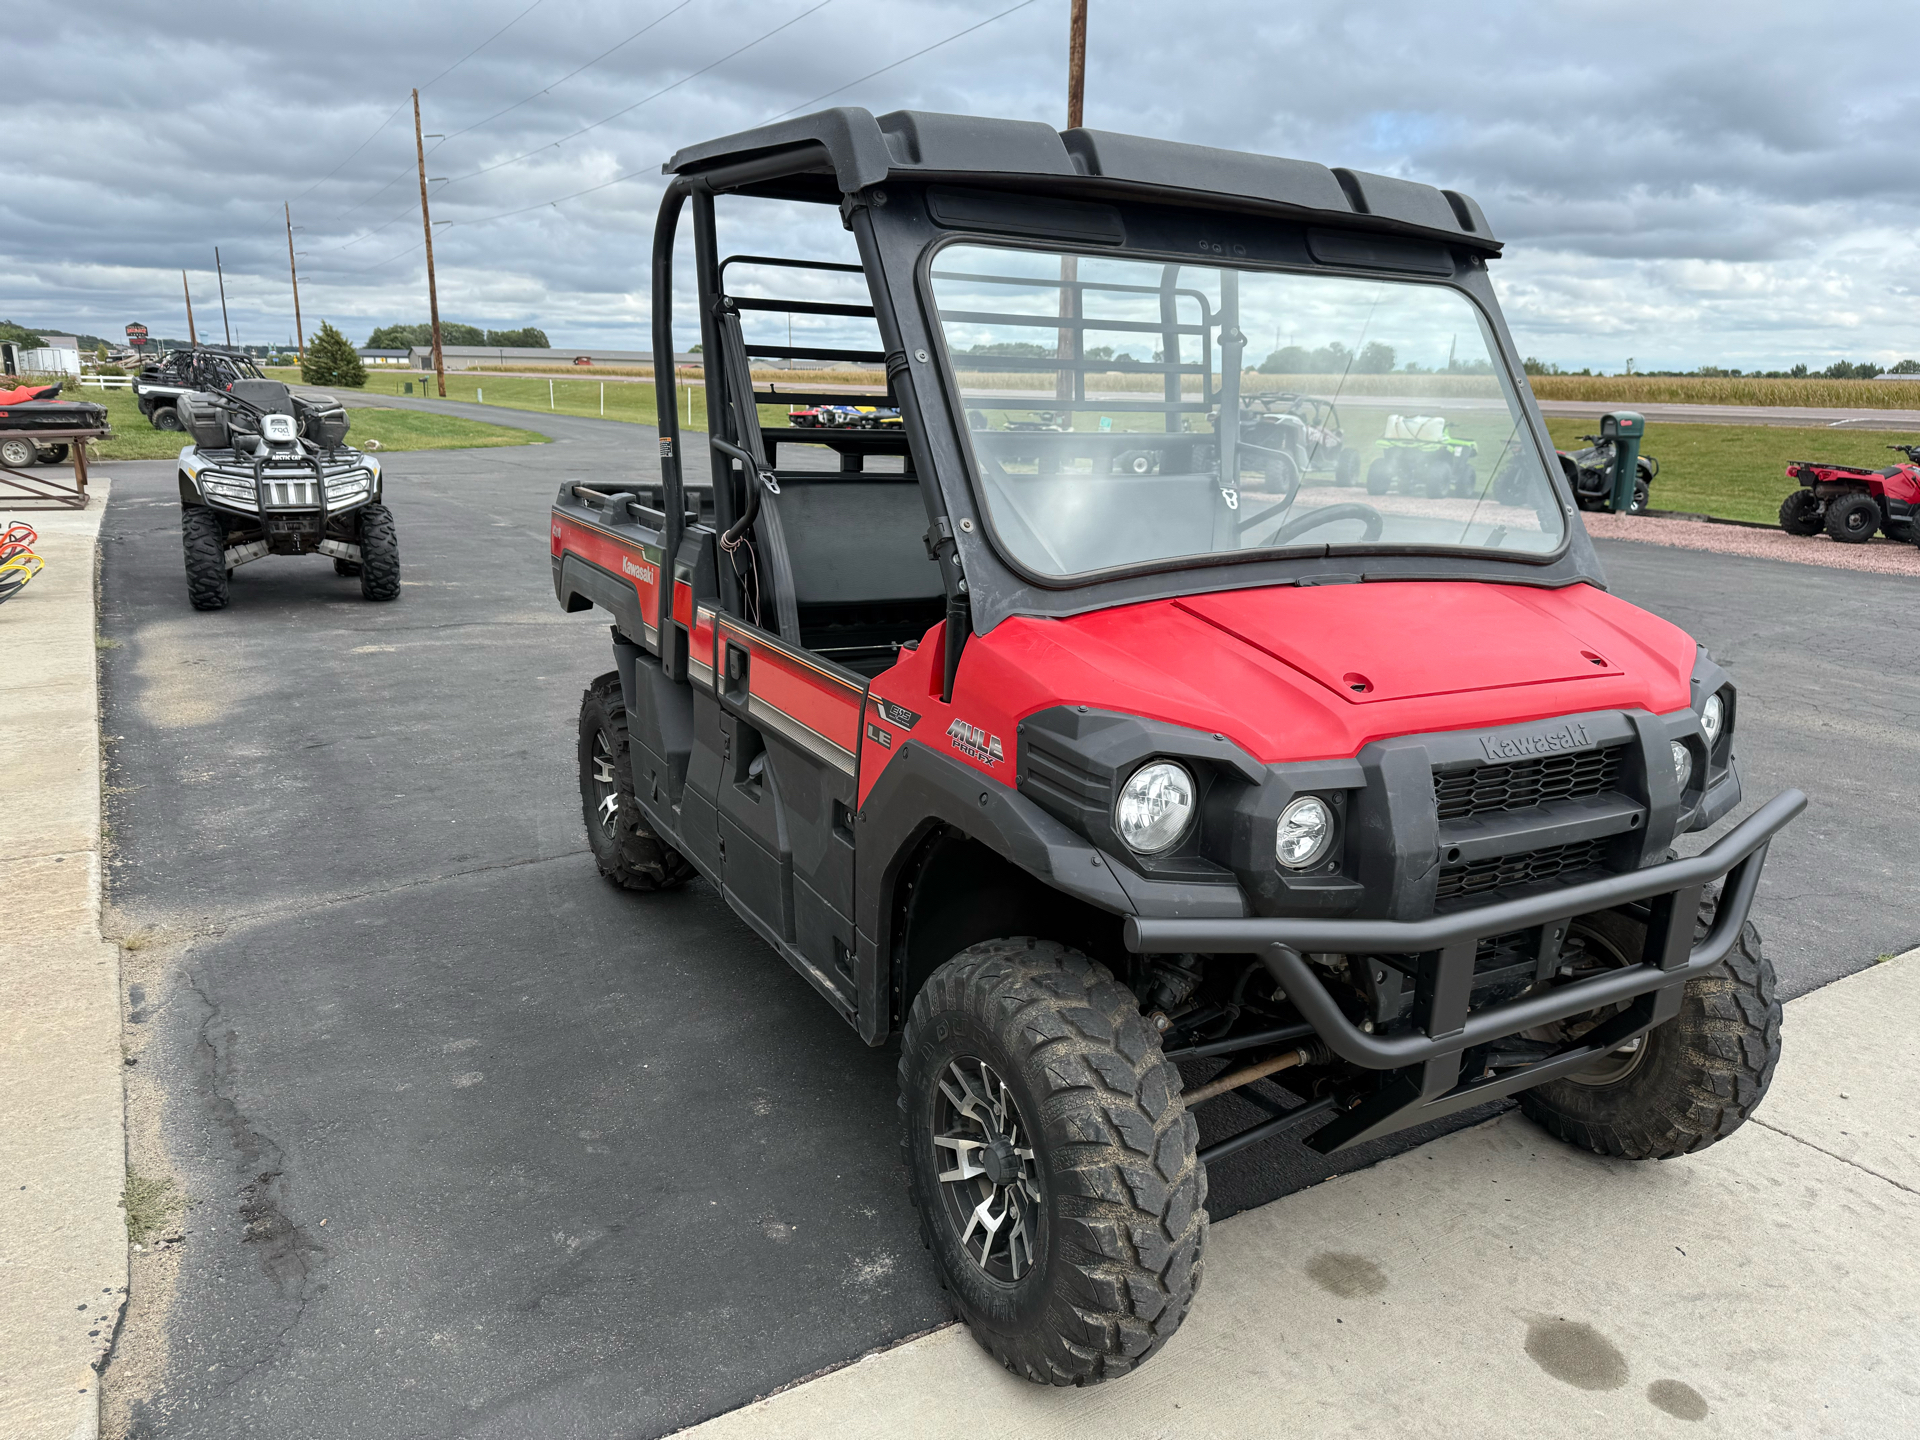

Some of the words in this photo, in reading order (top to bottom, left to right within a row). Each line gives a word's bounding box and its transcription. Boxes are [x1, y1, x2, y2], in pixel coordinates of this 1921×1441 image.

[622, 555, 655, 586] Kawasaki
[867, 724, 891, 748] LE
[945, 717, 1006, 764] MULE
[1479, 723, 1593, 761] Kawasaki
[951, 739, 997, 769] PRO-FX
